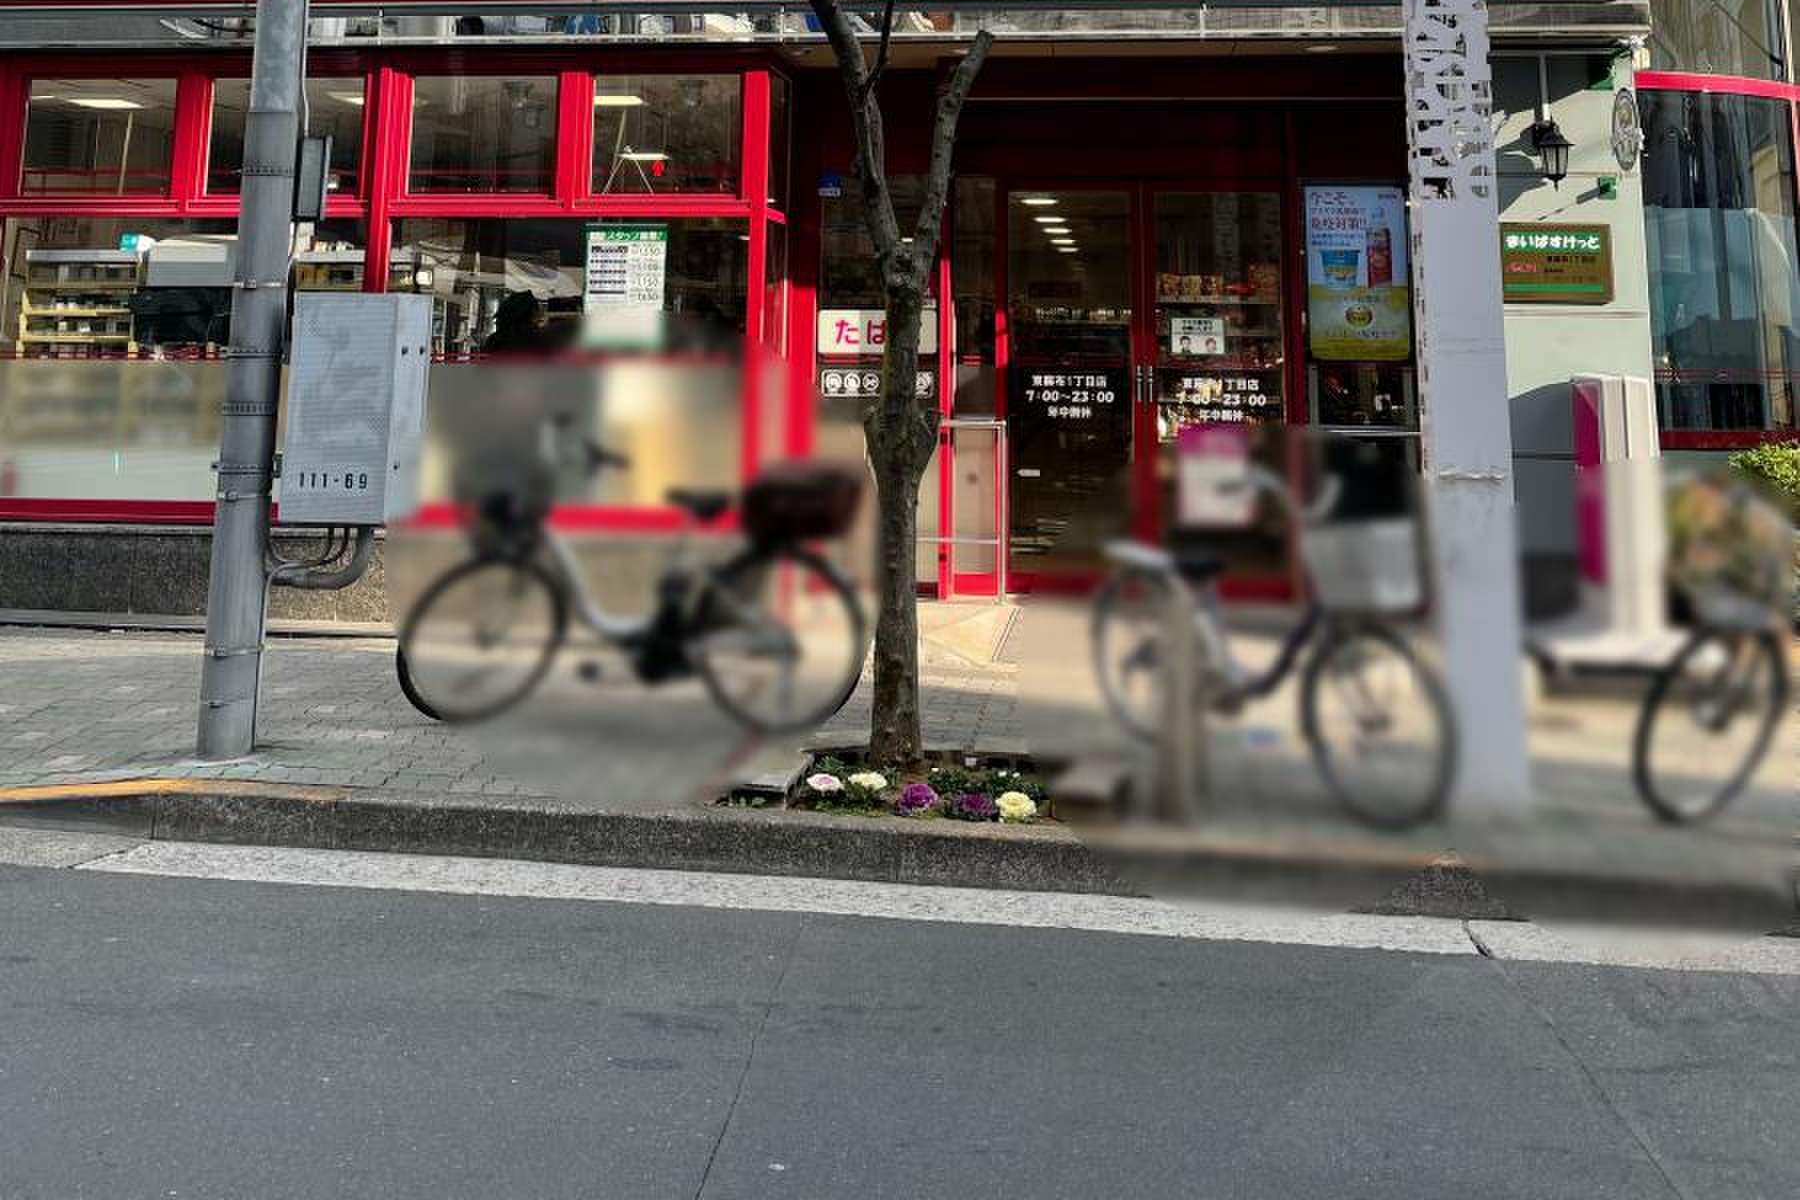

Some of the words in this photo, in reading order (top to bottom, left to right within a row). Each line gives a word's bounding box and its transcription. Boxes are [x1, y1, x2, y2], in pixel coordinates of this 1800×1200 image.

[1505, 235, 1600, 249] まいばすけっと
[835, 320, 887, 345] たば
[299, 472, 369, 490] 111-69
